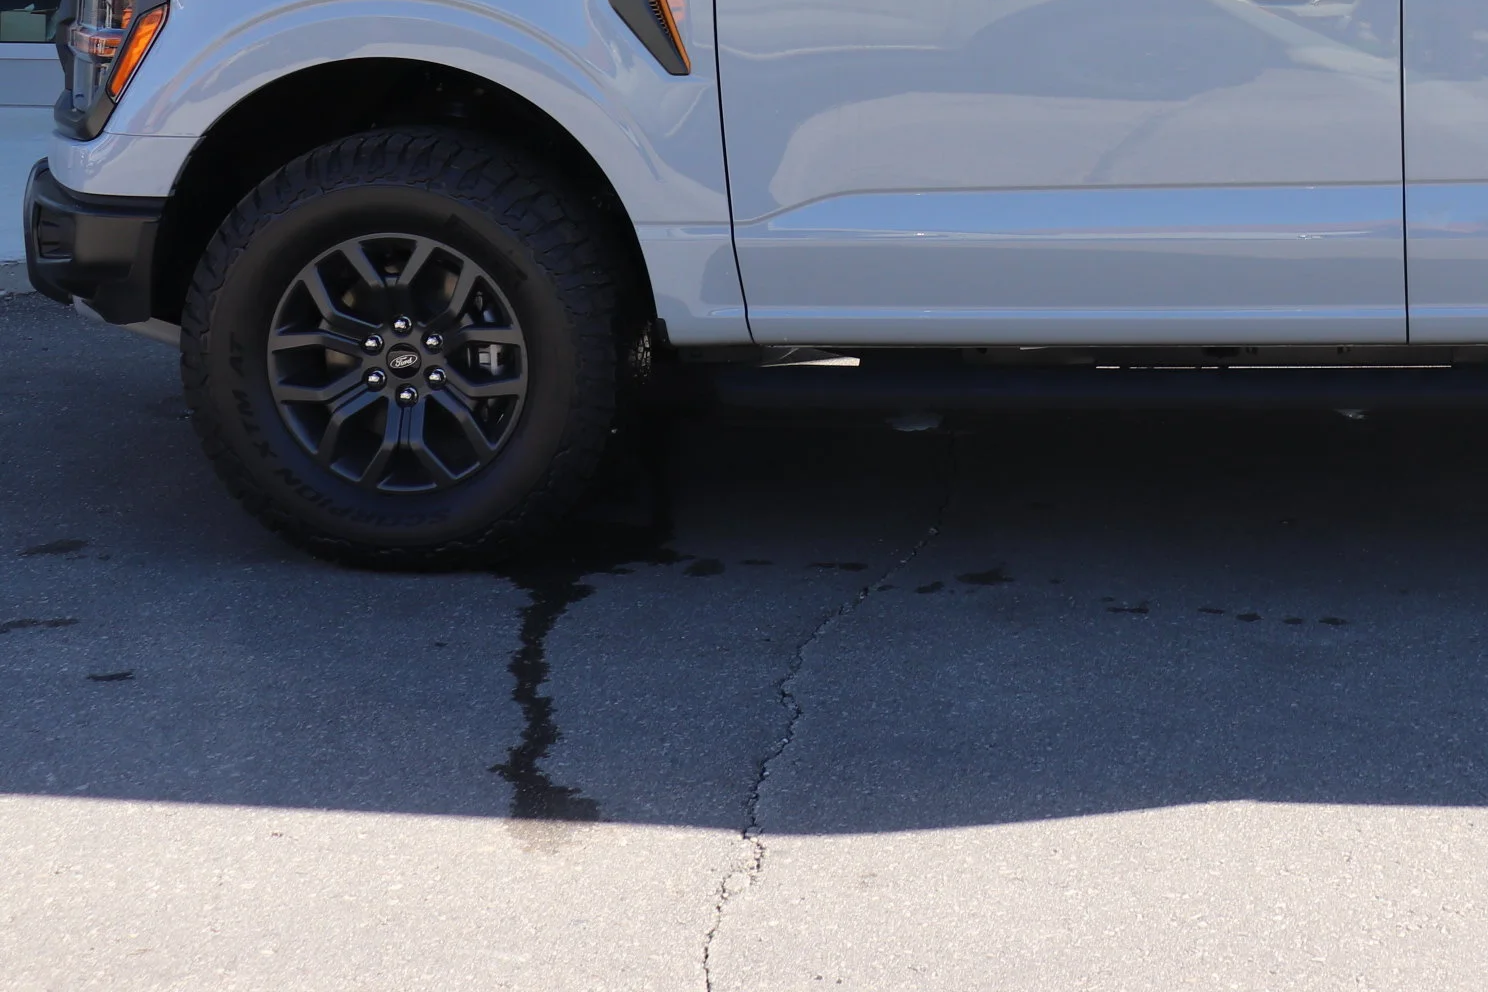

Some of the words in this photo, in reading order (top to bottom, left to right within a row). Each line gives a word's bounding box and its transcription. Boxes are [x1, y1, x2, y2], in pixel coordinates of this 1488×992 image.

[229, 331, 246, 377] AT
[393, 355, 414, 367] Ford
[231, 389, 278, 458] XTM
[273, 467, 451, 528] SCORPION
